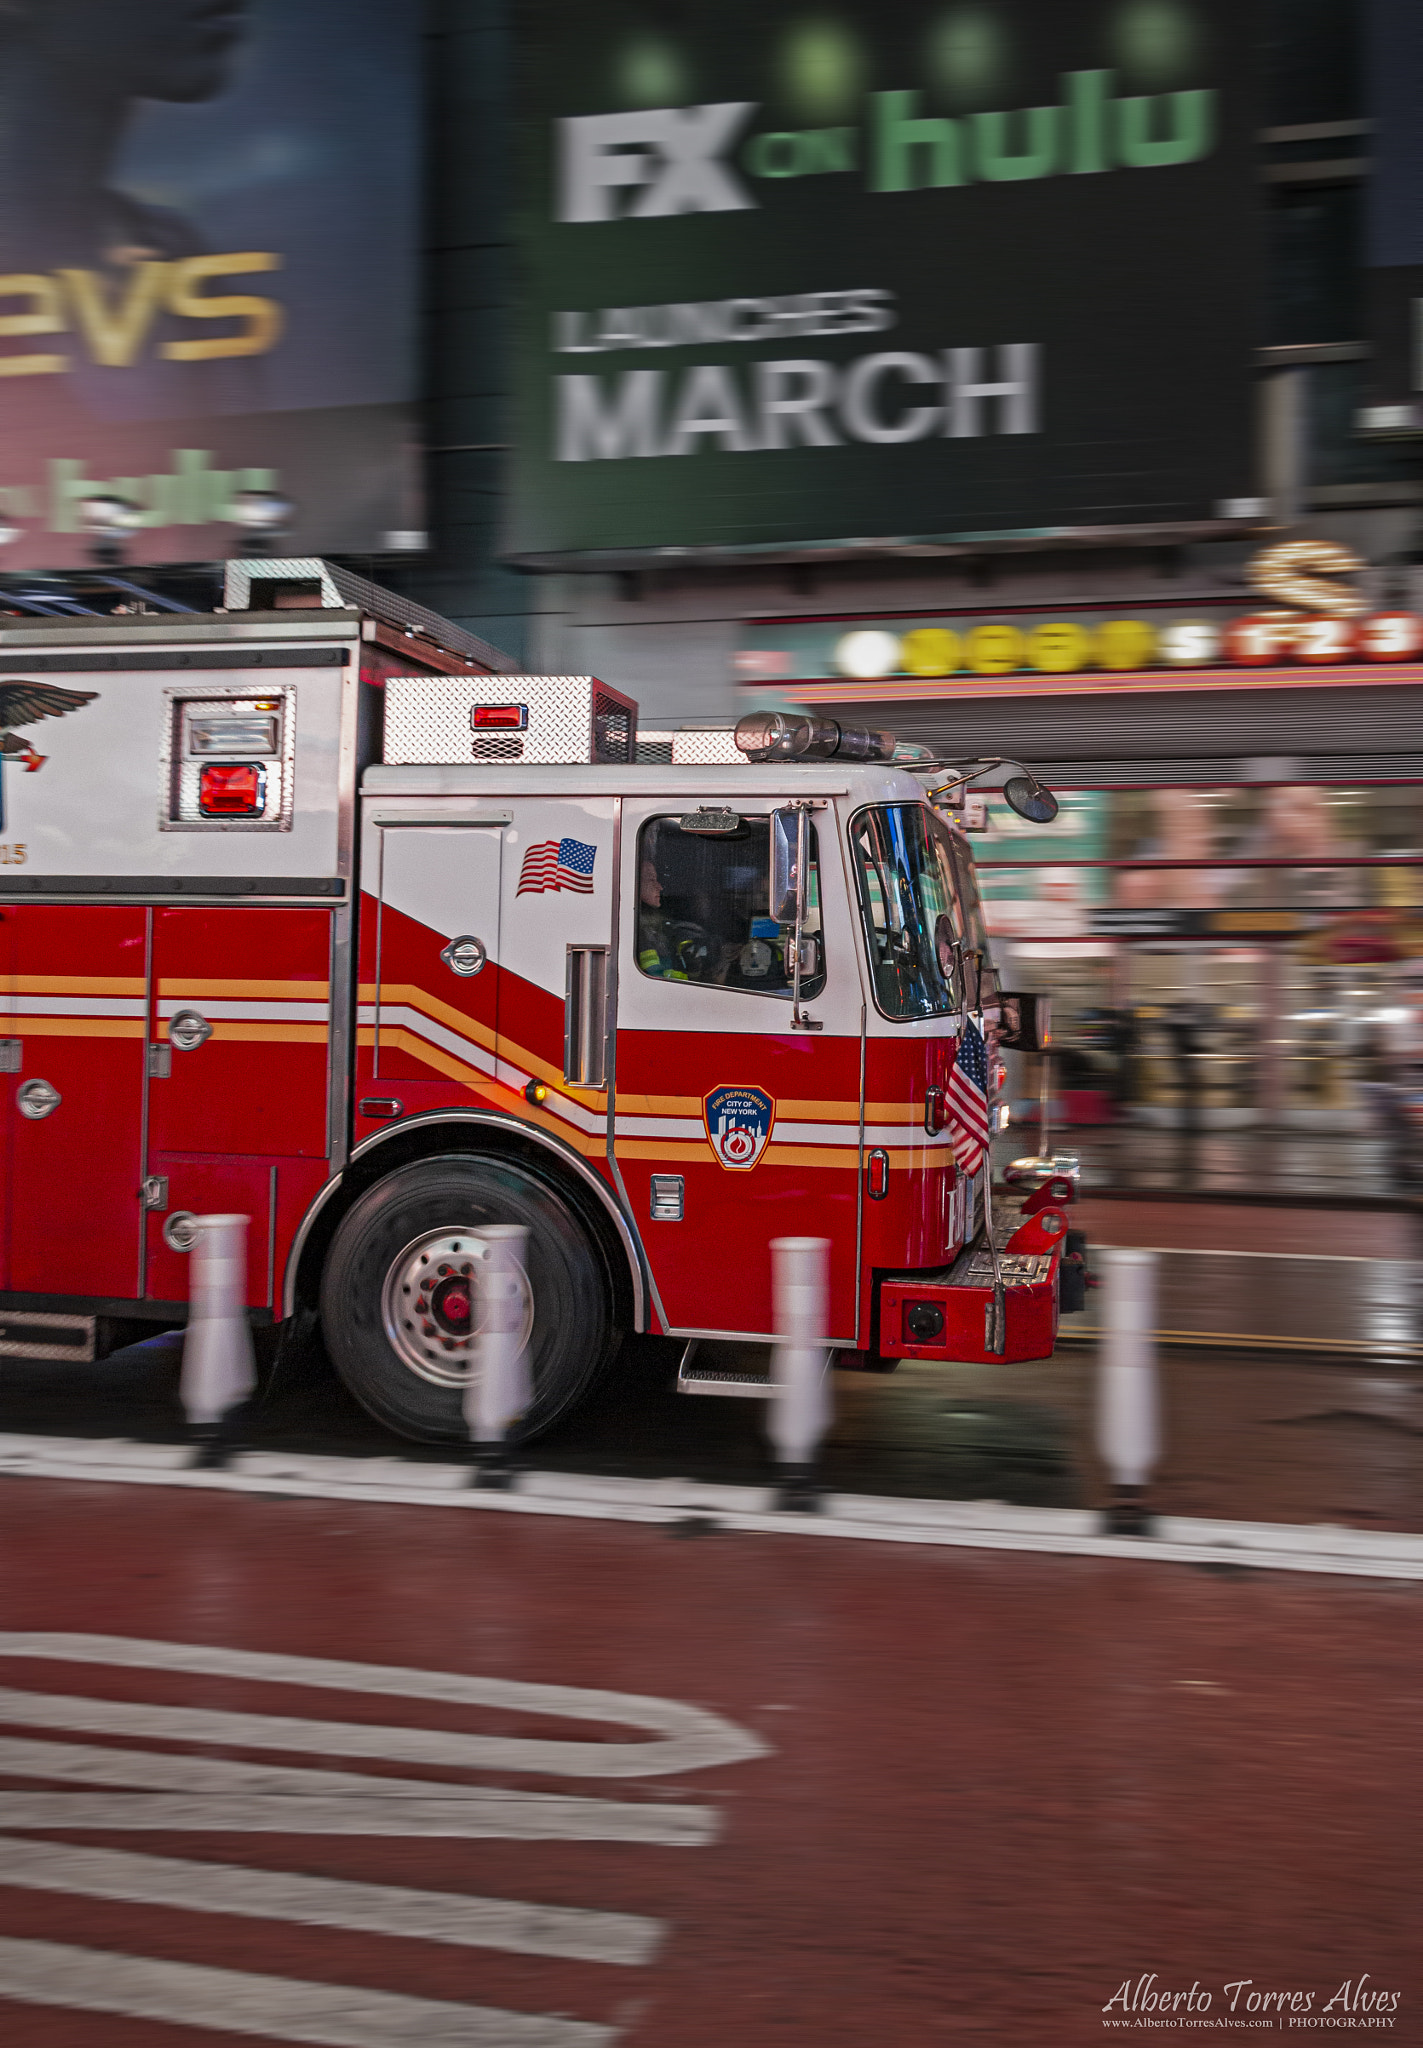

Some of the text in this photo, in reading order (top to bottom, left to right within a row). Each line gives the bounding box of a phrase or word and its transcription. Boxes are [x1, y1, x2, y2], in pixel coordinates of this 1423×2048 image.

[553, 101, 762, 223] FX
[866, 68, 1217, 193] hulu
[550, 288, 897, 353] LAUNCHES
[553, 343, 1044, 462] MARCH
[711, 1090, 767, 1110] FIRE DEPARTMENT
